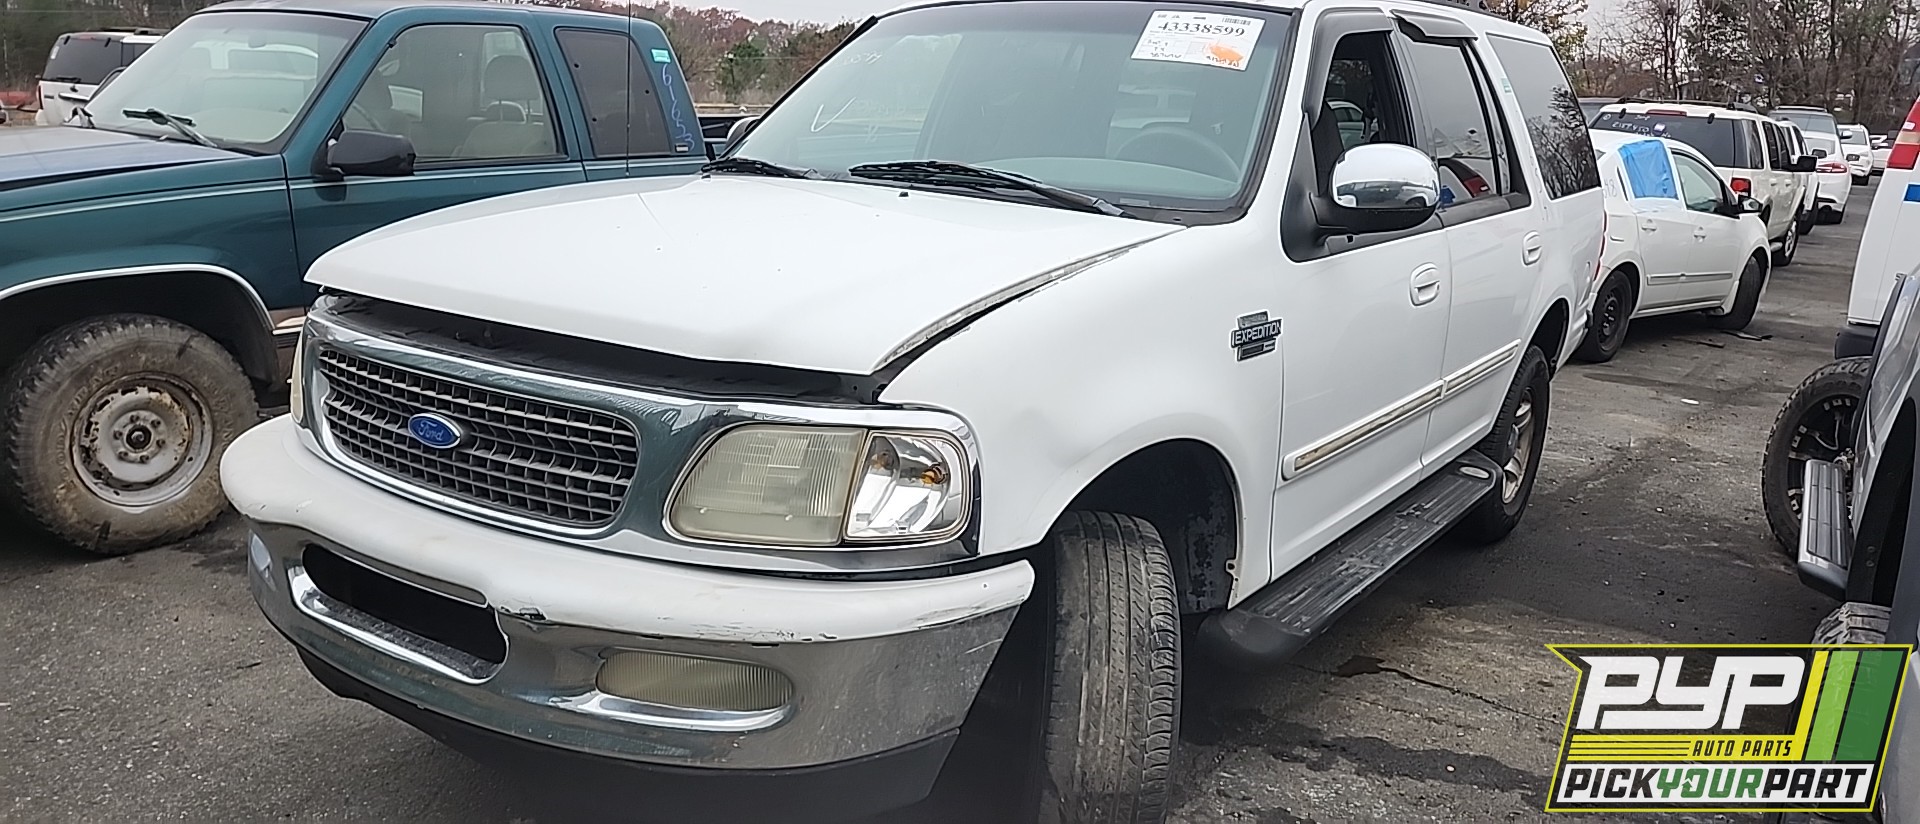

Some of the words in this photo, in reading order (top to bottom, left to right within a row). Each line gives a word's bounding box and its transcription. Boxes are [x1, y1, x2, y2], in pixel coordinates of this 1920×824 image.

[1157, 21, 1246, 37] 43338599
[1234, 321, 1281, 345] EXPEDITION
[418, 420, 444, 441] Ford
